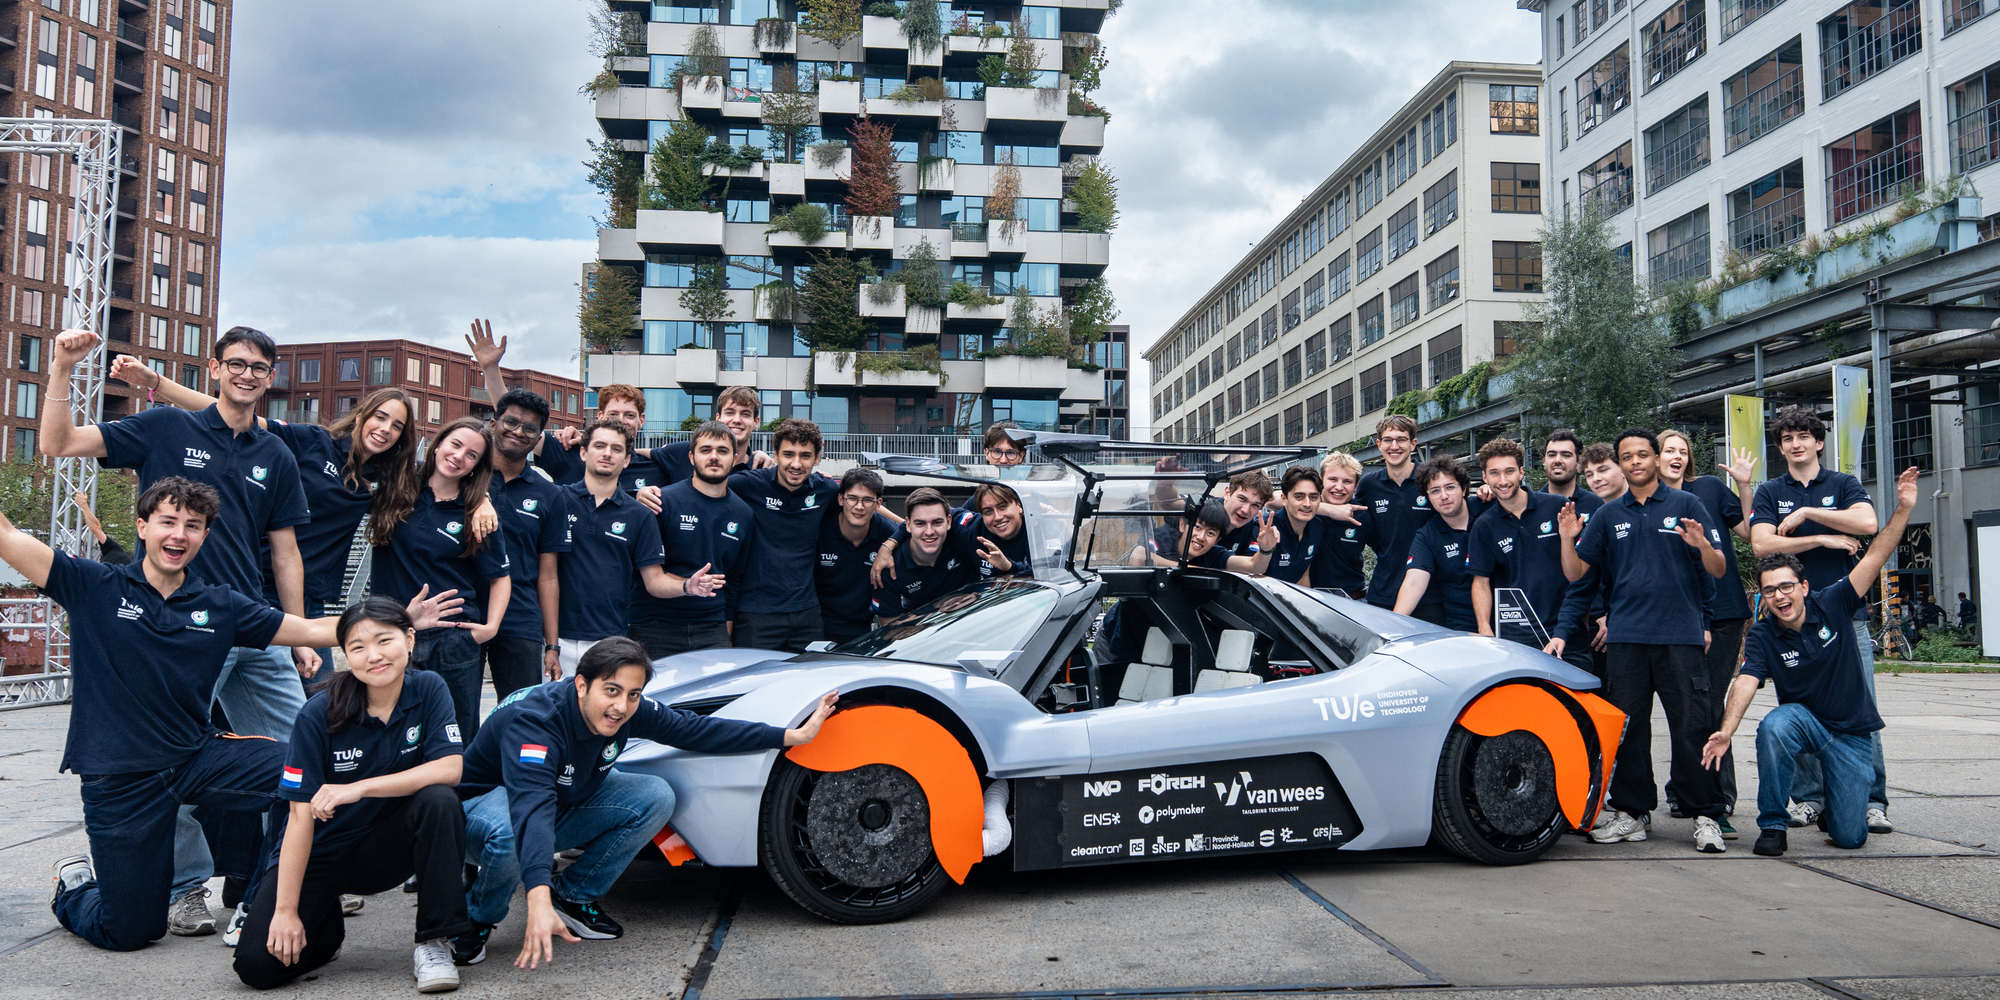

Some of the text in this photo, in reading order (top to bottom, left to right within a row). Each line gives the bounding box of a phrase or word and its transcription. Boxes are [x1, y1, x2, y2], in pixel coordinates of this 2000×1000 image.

[185, 447, 211, 460] TU/e
[765, 496, 783, 506] TU/e
[680, 514, 699, 523] TU/e
[1781, 650, 1800, 660] TU/e
[1377, 689, 1418, 699] EINDHOVEN
[1312, 693, 1376, 722] TU/e
[1378, 698, 1418, 707] UNIVERSITY
[1380, 705, 1427, 716] TECHNOLOGY
[333, 747, 363, 761] TU/e
[1083, 780, 1122, 797] NXP
[1246, 786, 1325, 805] van wees
[1156, 804, 1206, 822] polymaker
[1242, 807, 1267, 815] TAILORING
[1312, 827, 1329, 838] GFS
[1212, 835, 1239, 843] Provincie
[1152, 836, 1180, 854] SNEP
[1212, 840, 1255, 850] Noord-Holland
